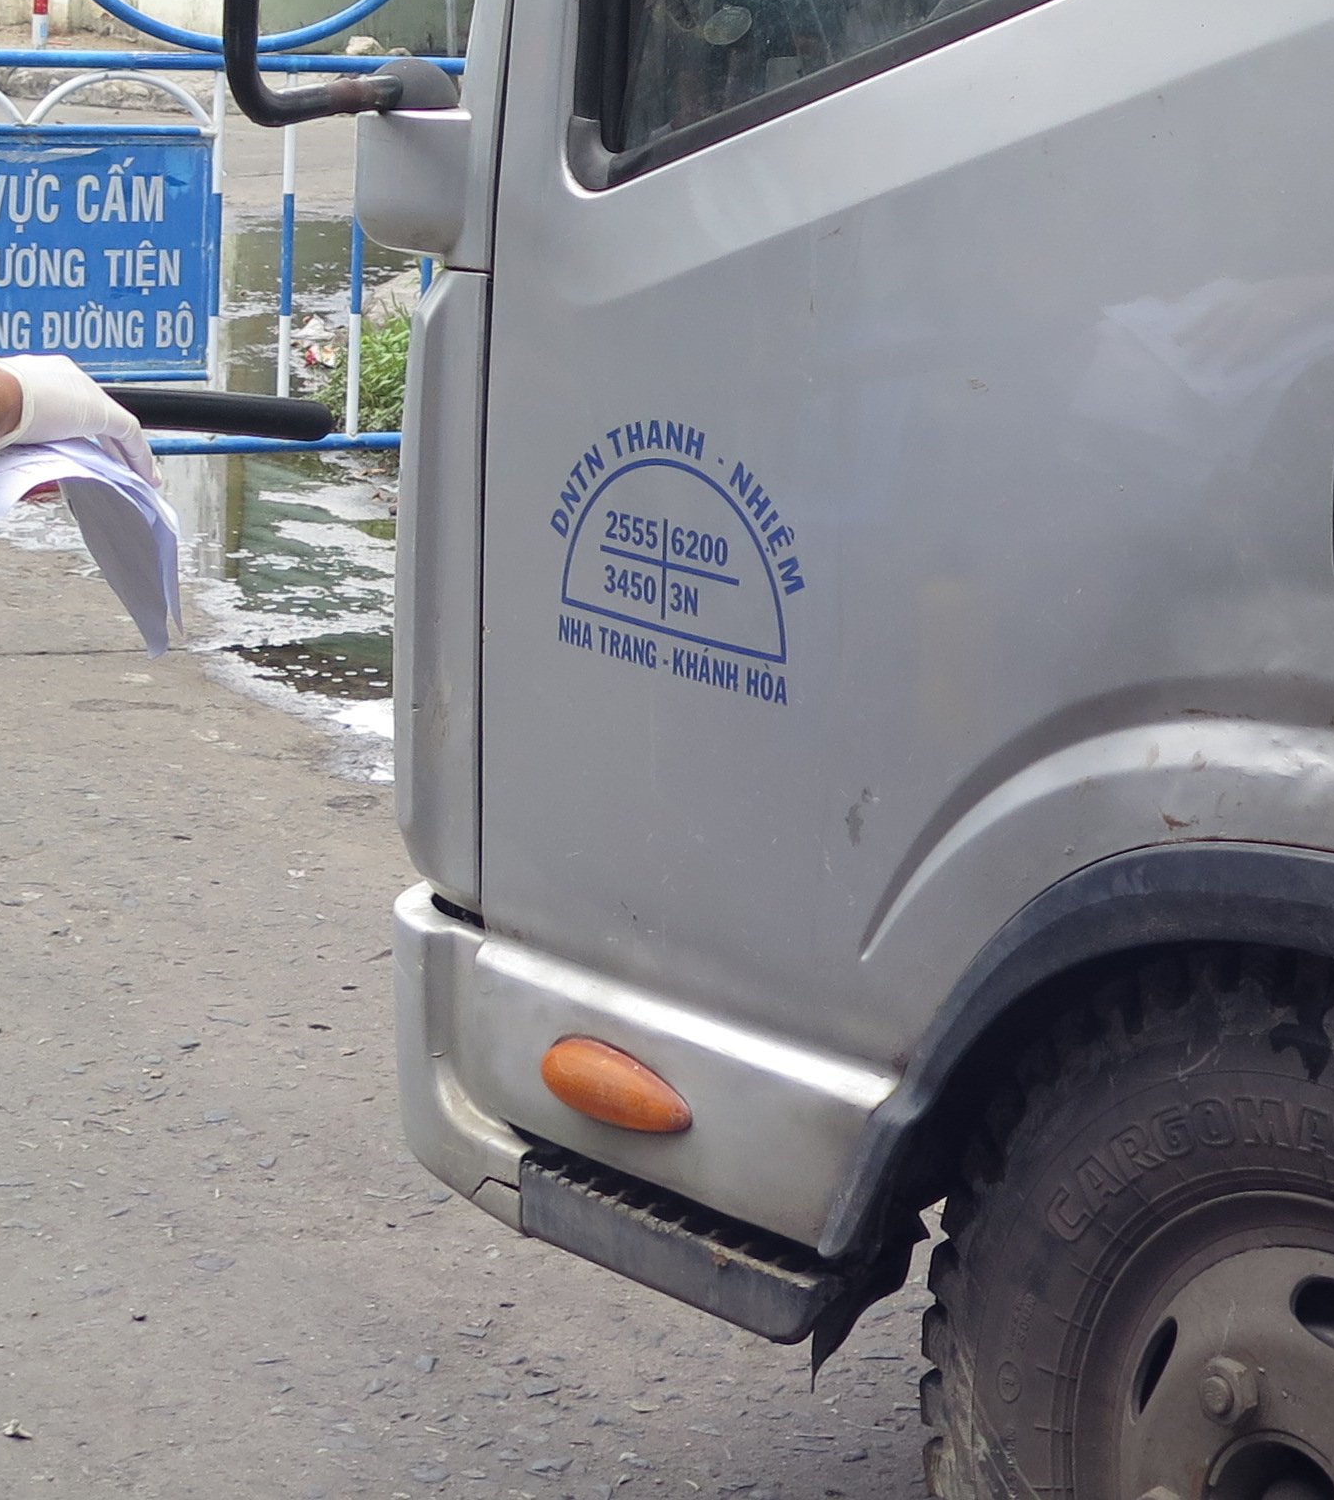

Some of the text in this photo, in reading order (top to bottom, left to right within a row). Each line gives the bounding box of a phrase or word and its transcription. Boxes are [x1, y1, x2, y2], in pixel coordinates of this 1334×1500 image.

[76, 157, 164, 223] CẤM
[104, 240, 180, 295] TIỆN
[42, 301, 144, 350] ĐƯỜNG
[156, 301, 194, 356] BỘ
[550, 444, 606, 539] DNTN
[606, 419, 706, 461] THANH
[729, 461, 806, 596] NHIỆM
[605, 510, 728, 567] 2555 6200
[604, 564, 698, 617] 3450 3N
[558, 614, 592, 651] NHA
[599, 626, 658, 669] TRANG
[672, 647, 739, 692] KHÁNH
[746, 663, 788, 706] HÒA
